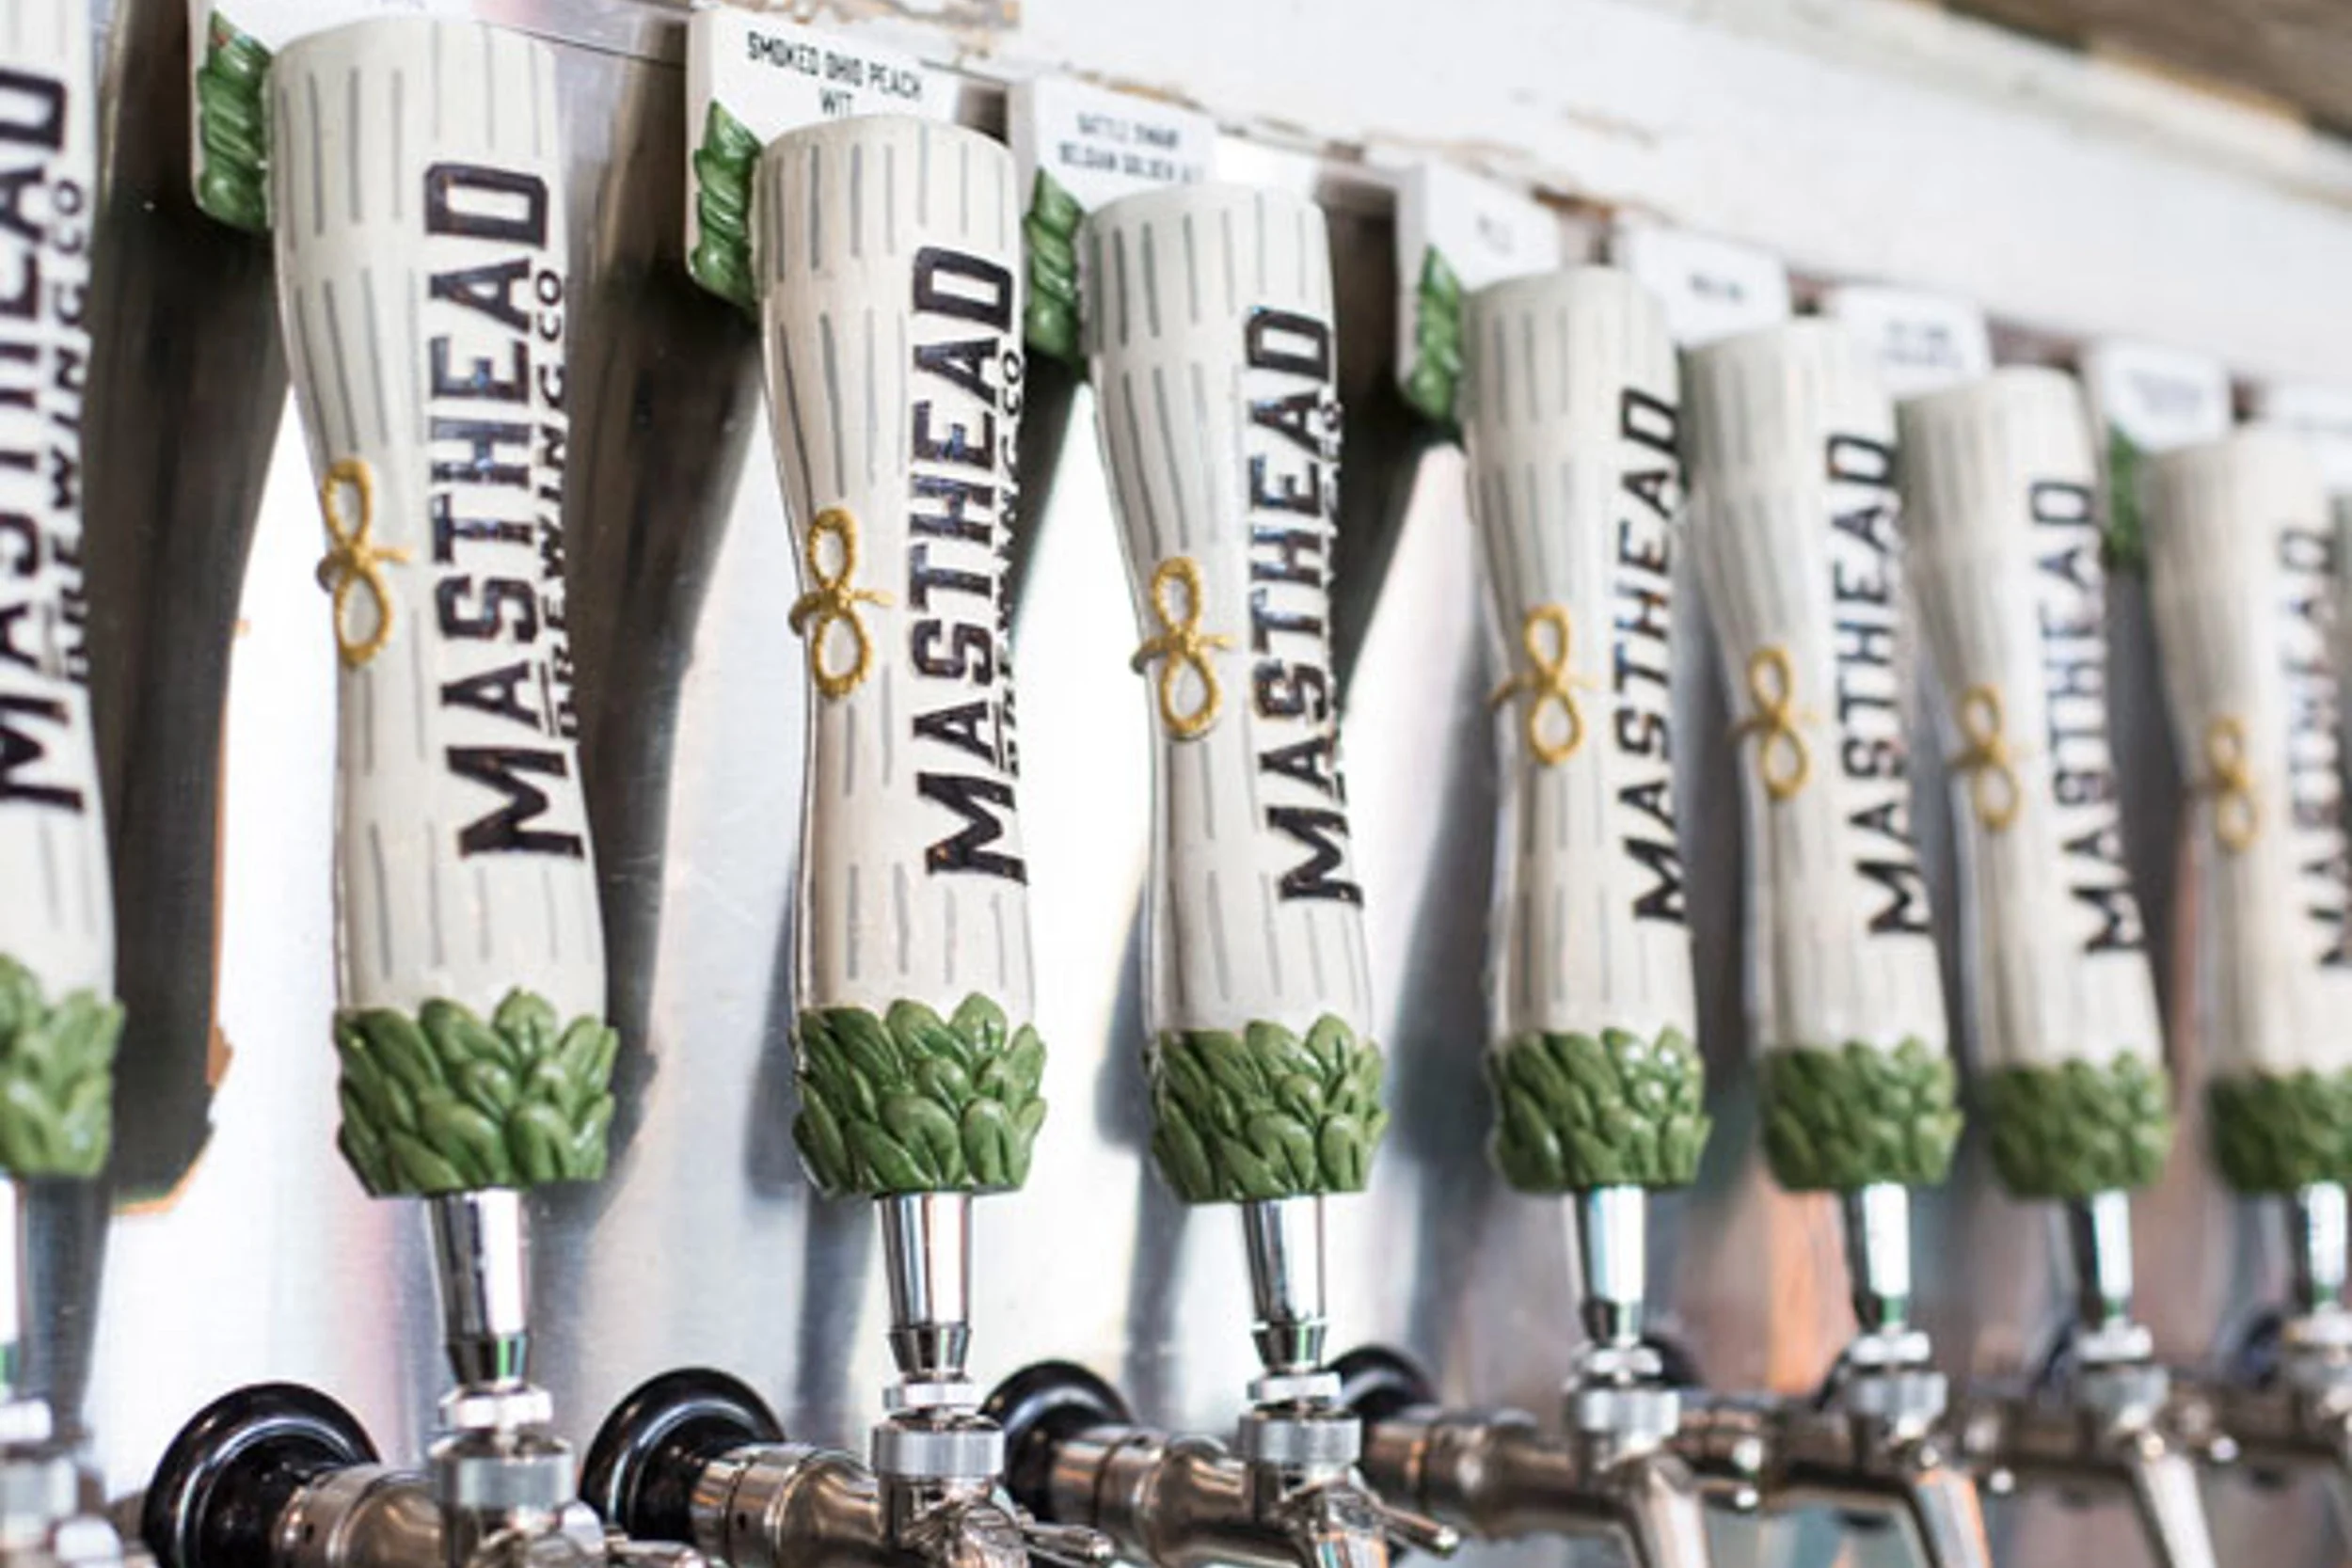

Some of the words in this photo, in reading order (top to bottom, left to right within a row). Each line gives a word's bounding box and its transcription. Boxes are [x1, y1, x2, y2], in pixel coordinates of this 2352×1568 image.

[537, 269, 564, 344] CO
[748, 31, 819, 75] SMOKED
[868, 62, 922, 99] PEACH
[423, 162, 584, 859] MASTHEAD
[911, 245, 1028, 886] MASTHEAD
[1245, 306, 1364, 908] MASTHEAD
[1612, 388, 1691, 926] MASTHEAD
[1825, 434, 1931, 936] MASTHEAD
[2028, 481, 2147, 955] MASTHEAD
